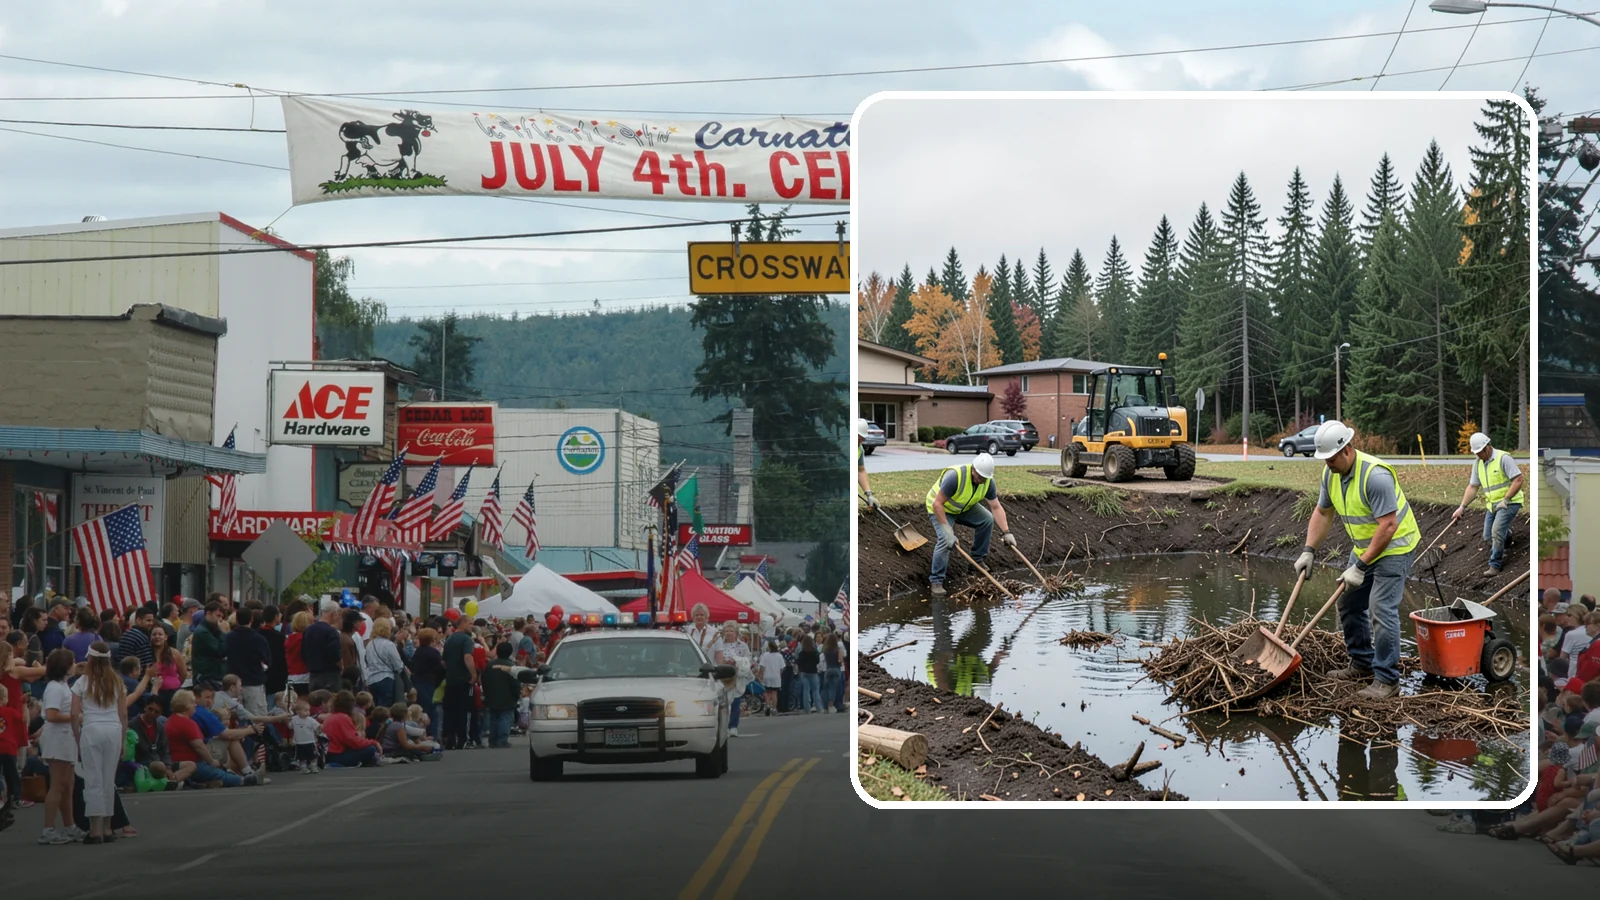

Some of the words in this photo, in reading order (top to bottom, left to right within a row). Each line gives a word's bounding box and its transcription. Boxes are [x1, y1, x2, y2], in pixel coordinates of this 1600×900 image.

[481, 141, 604, 193] JULY
[632, 149, 746, 198] 4th.
[697, 254, 850, 280] CROSSWA
[283, 380, 373, 420] ACE
[406, 409, 452, 422] CEDAR
[461, 409, 485, 422] LOG
[284, 420, 371, 436] Hardware
[83, 485, 94, 494] St.
[95, 485, 124, 495] Vincent
[126, 486, 136, 494] de
[138, 486, 155, 495] Paul
[213, 516, 331, 535] HARDARE
[688, 526, 743, 536] CRNATION
[699, 535, 731, 543] GLASS
